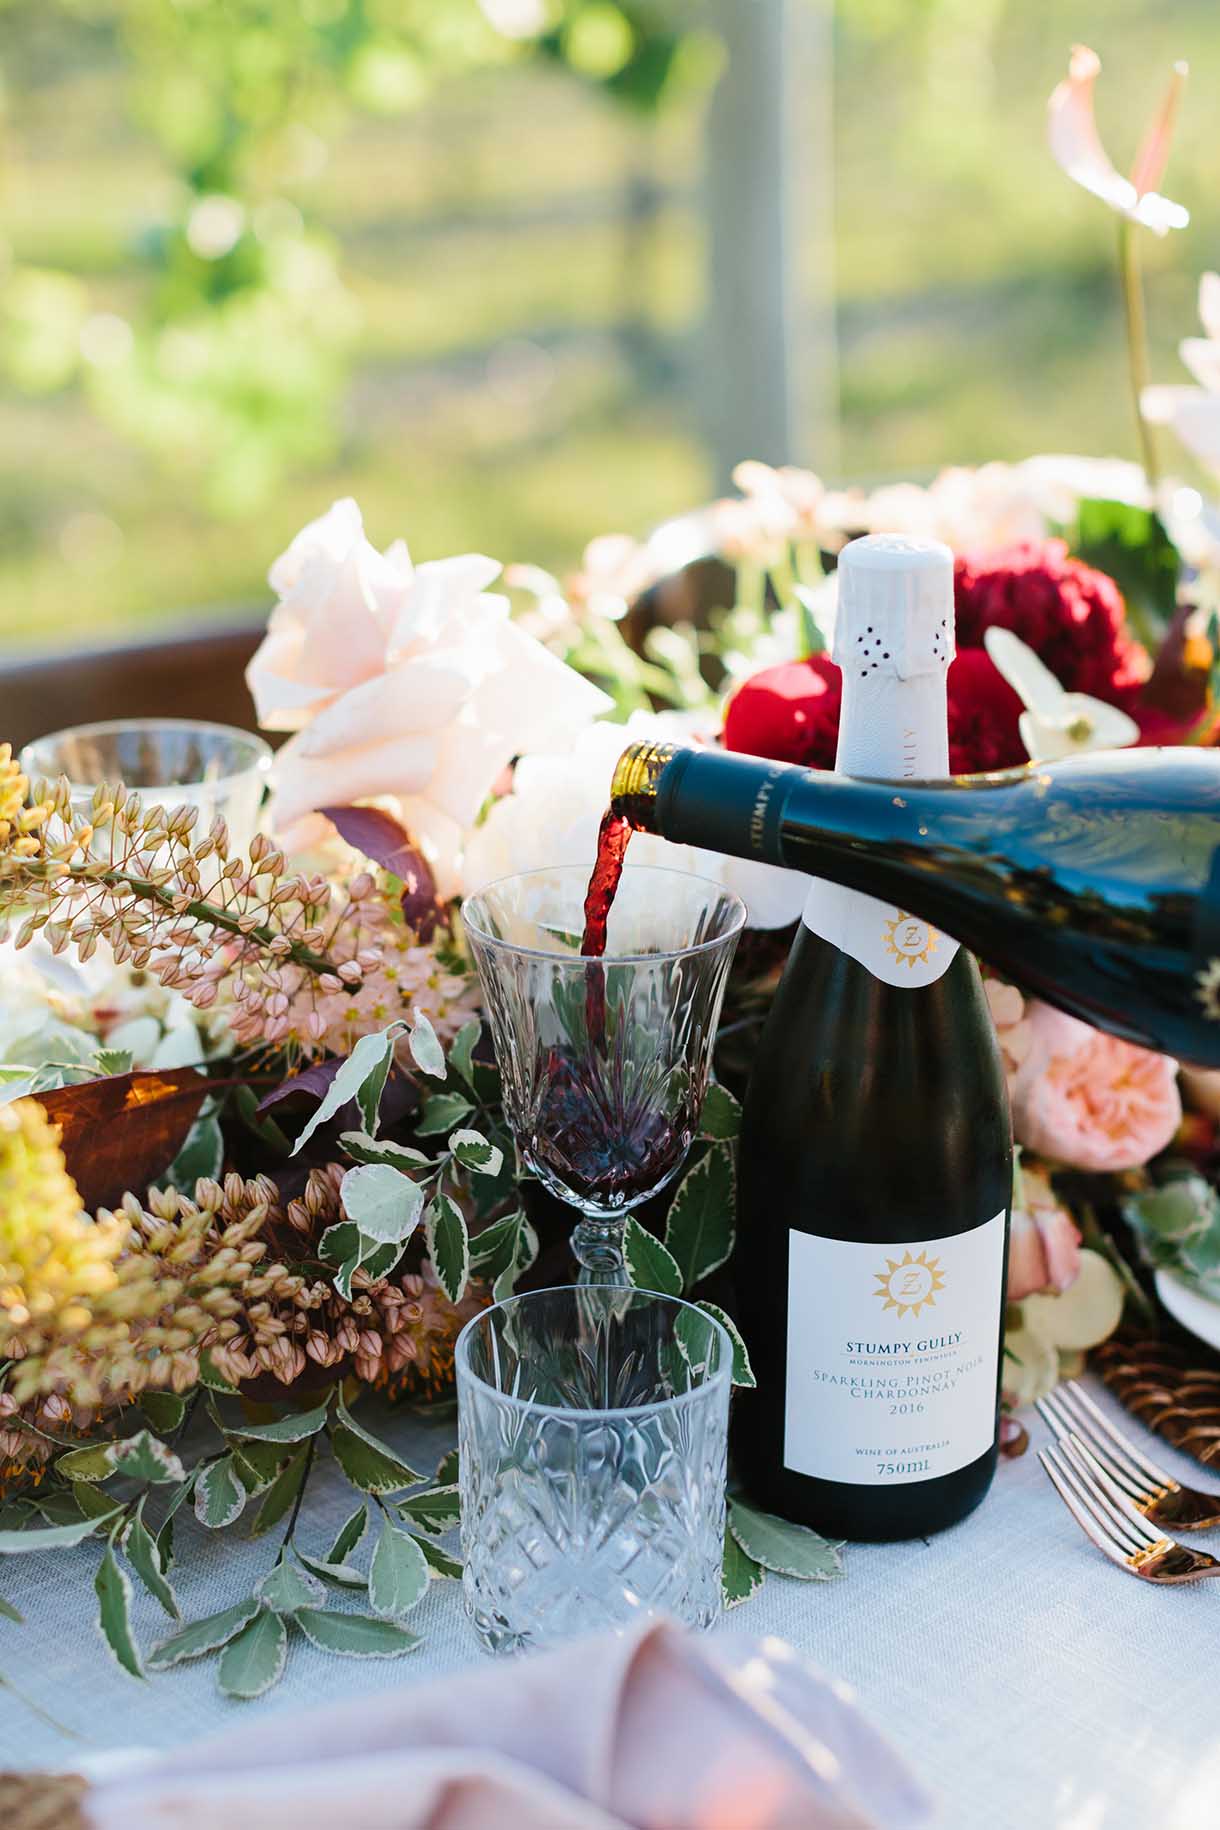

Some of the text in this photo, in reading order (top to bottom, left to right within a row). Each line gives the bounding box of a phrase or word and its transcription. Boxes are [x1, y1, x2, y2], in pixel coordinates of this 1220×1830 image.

[903, 728, 918, 778] ULLY
[846, 1331, 962, 1354] STUMPY GULLY
[849, 1350, 957, 1367] MORNINGTON PENINSULA
[813, 1355, 984, 1389] SPARKLING PINOT NOIR
[850, 1379, 957, 1399] CHARDONNAY
[889, 1402, 925, 1416] 2016
[855, 1439, 951, 1456] WINE OF AUSTRALIA
